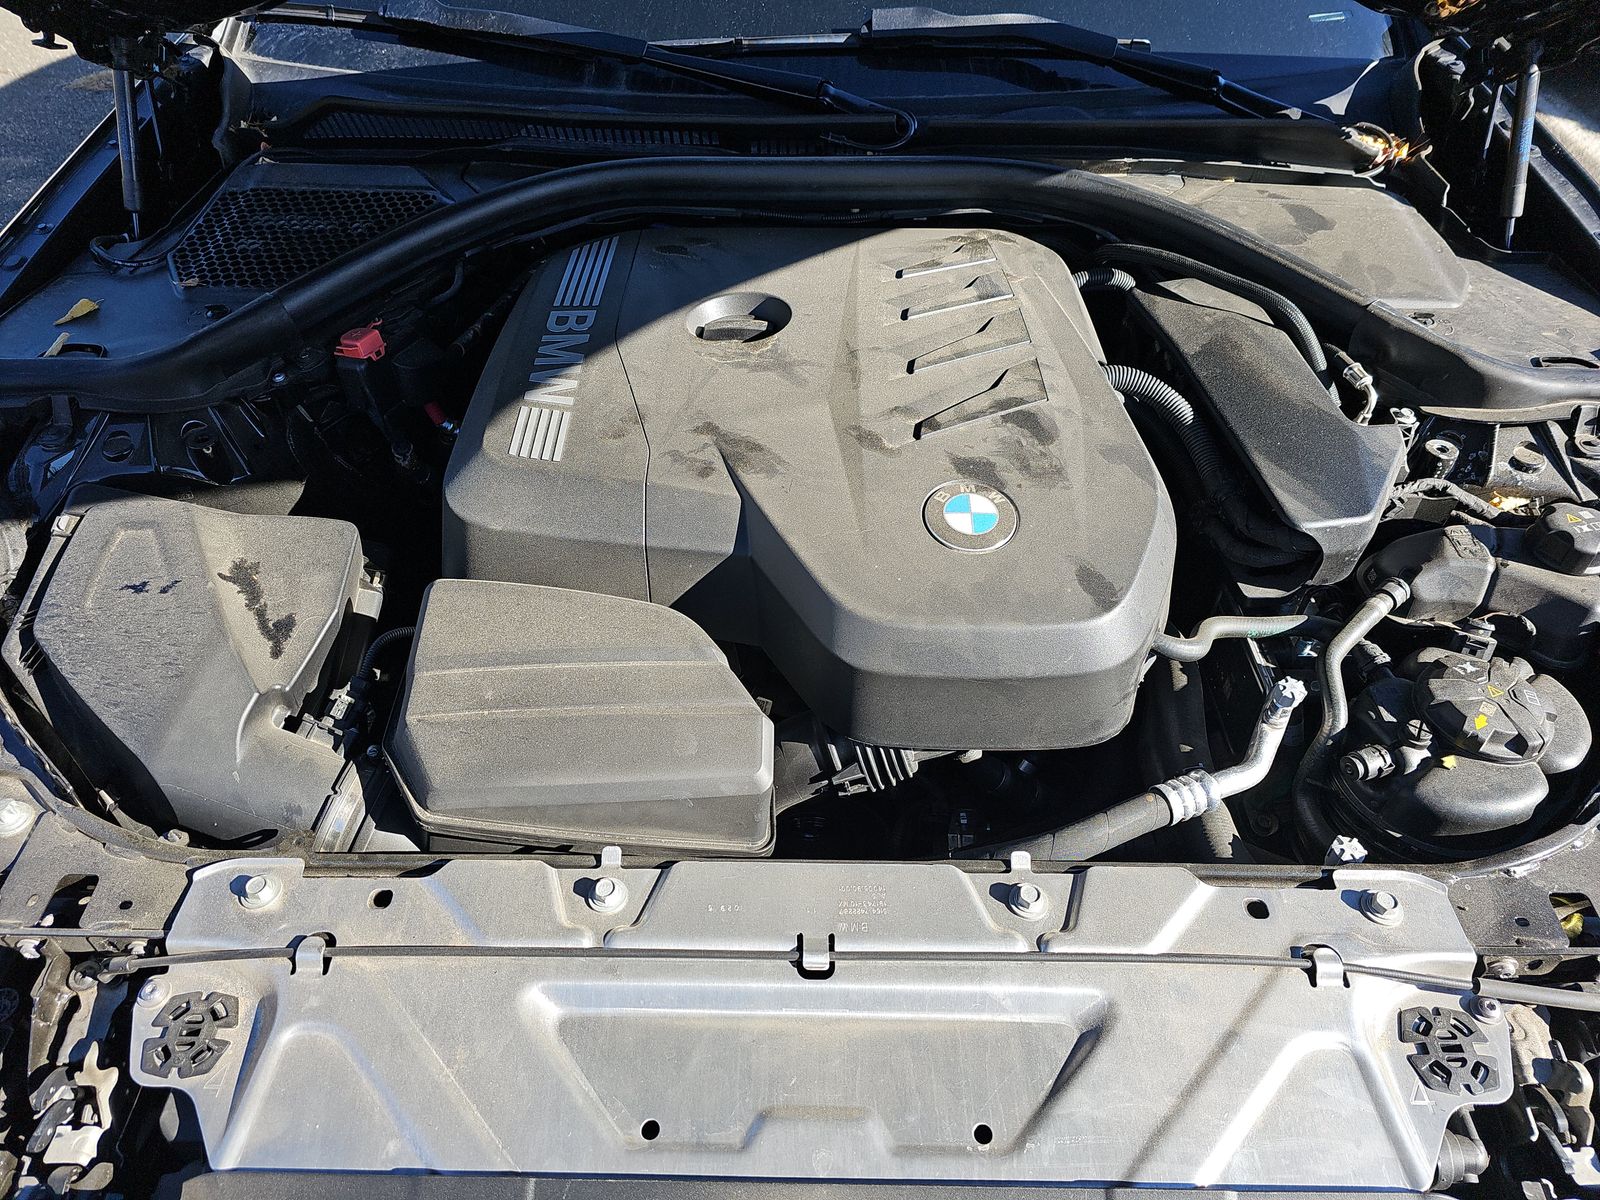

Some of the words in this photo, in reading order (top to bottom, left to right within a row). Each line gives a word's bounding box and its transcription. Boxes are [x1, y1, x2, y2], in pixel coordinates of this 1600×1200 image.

[523, 309, 597, 406] BMW
[933, 484, 1005, 504] BMW
[838, 922, 868, 933] BMW
[1410, 1078, 1437, 1115] 4
